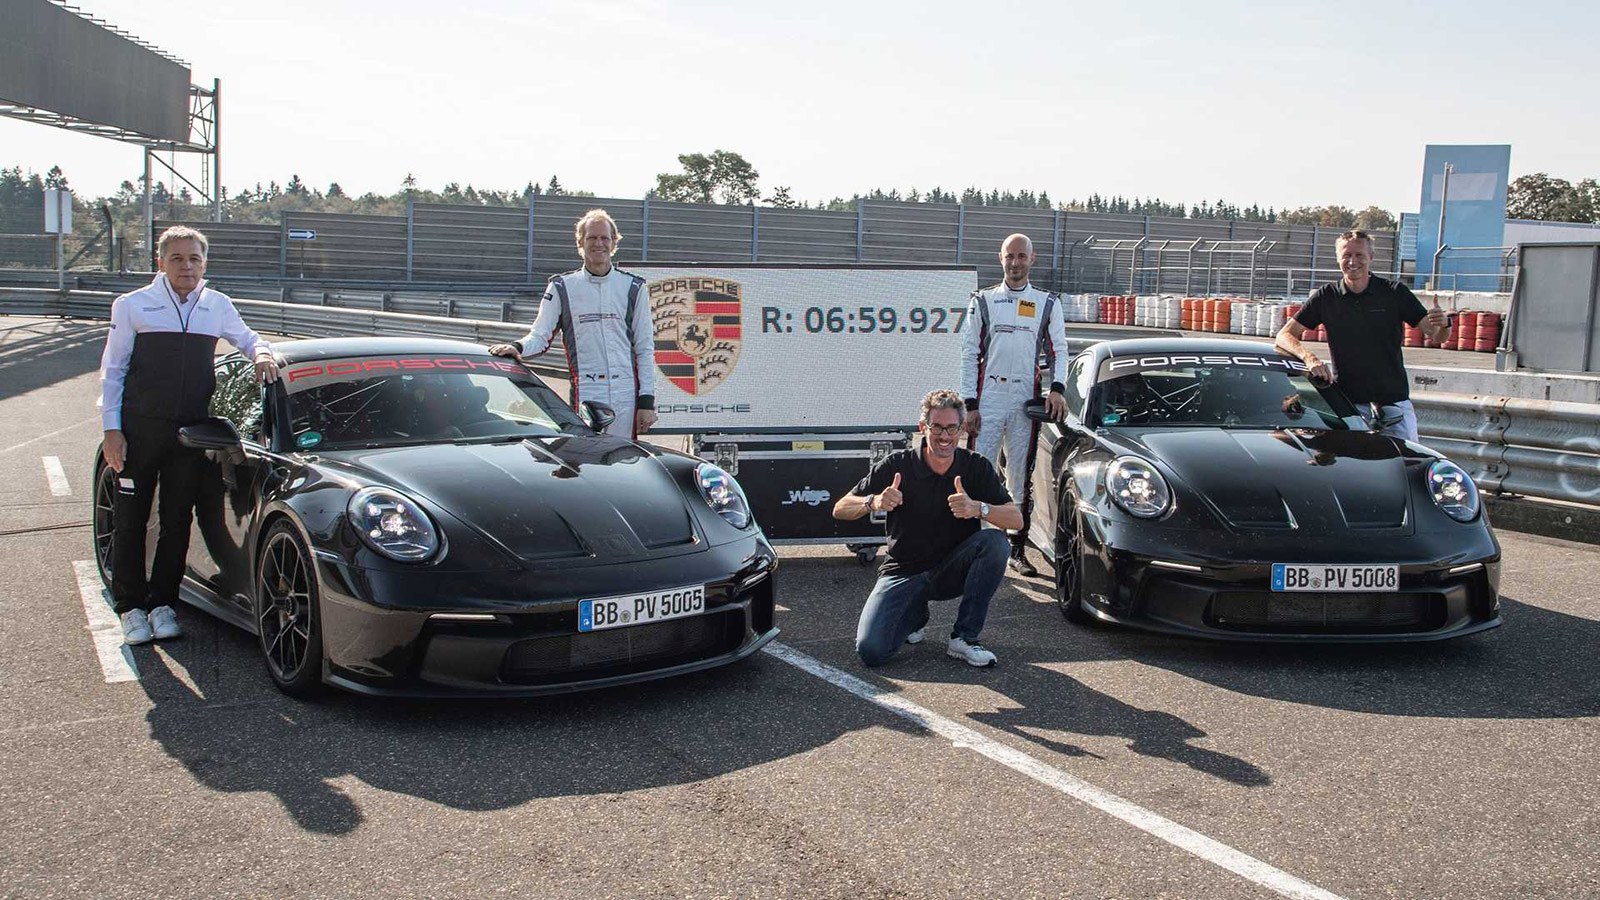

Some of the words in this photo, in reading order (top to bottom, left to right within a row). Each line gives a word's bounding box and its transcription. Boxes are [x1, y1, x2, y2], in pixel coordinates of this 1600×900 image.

[649, 280, 738, 296] PORSCHE
[761, 306, 793, 333] R:
[804, 306, 967, 334] 06:59.927
[289, 359, 526, 383] PORSCHE
[1109, 355, 1310, 372] PORSCHE
[658, 403, 750, 413] ORSCHE
[1286, 568, 1309, 587] BB
[1324, 568, 1348, 588] PV
[1352, 567, 1396, 588] 5008
[594, 602, 618, 625] BB
[634, 597, 656, 620] PV
[661, 589, 702, 616] 5005
